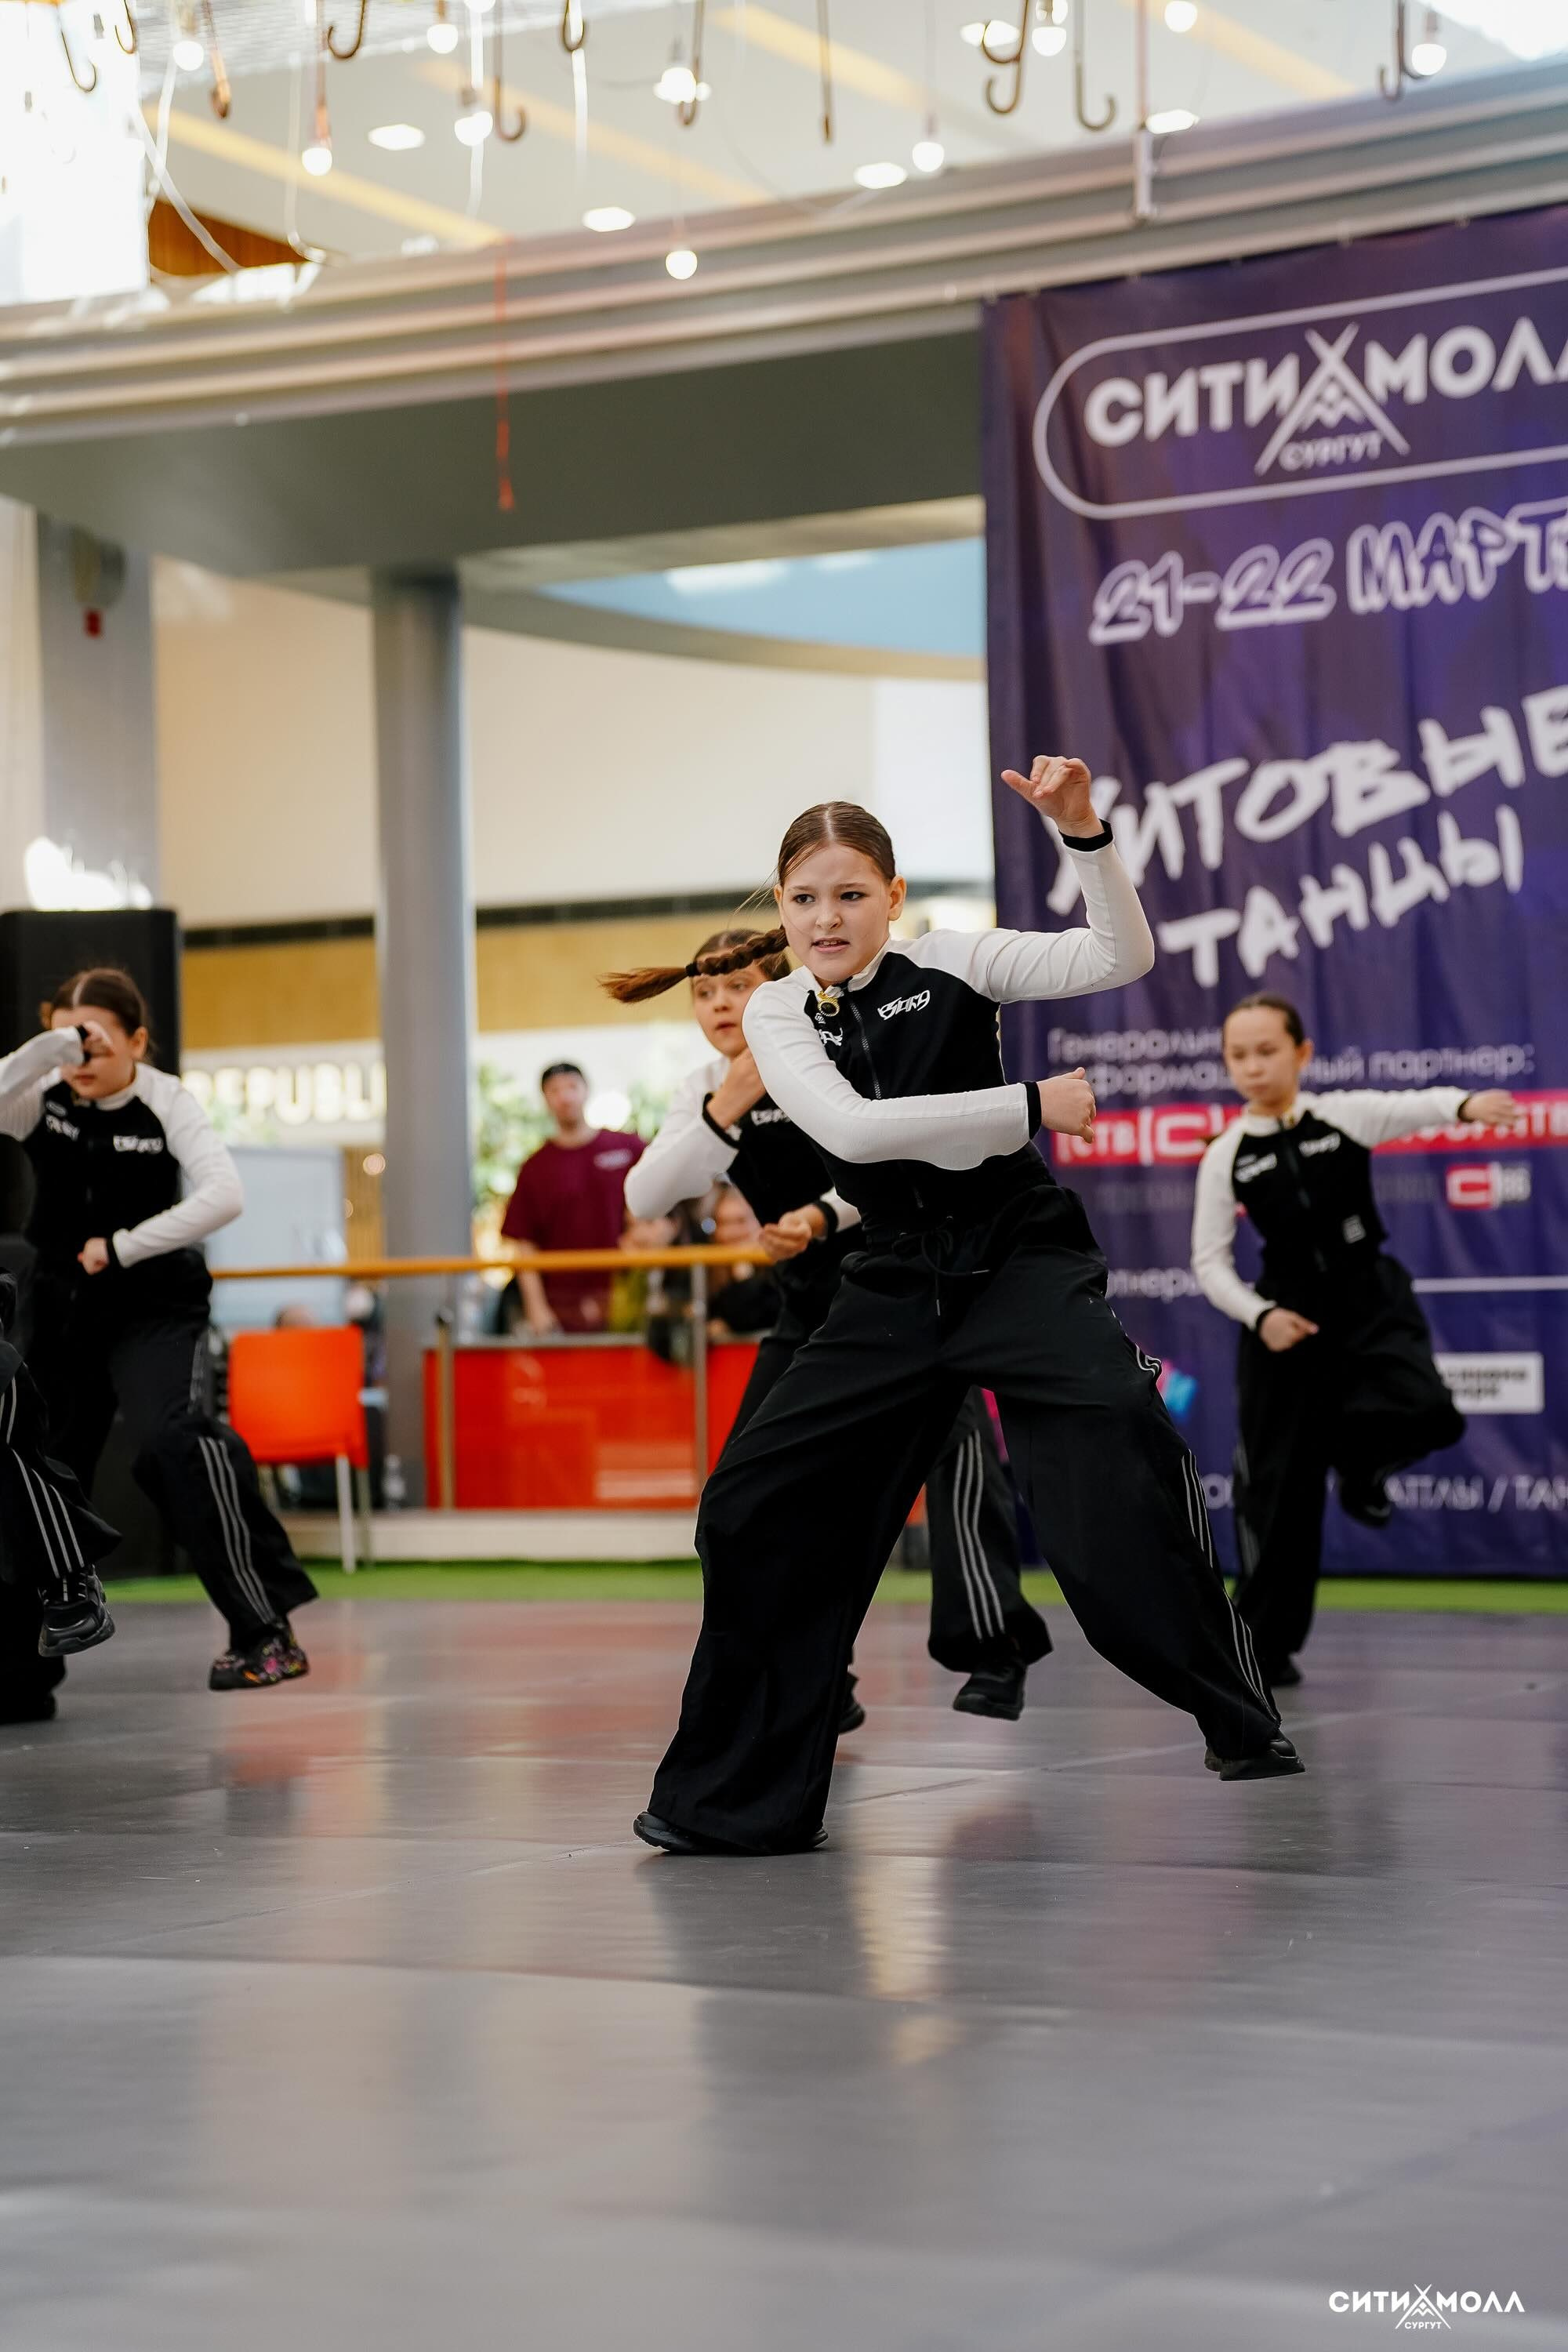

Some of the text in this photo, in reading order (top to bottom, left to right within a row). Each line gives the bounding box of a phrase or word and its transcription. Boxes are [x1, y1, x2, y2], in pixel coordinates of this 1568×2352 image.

[1083, 316, 1568, 448] СИТИ МОЛ
[1088, 495, 1568, 646] 21-22 МАРТ
[1157, 804, 1524, 989] ТАНЦЫ
